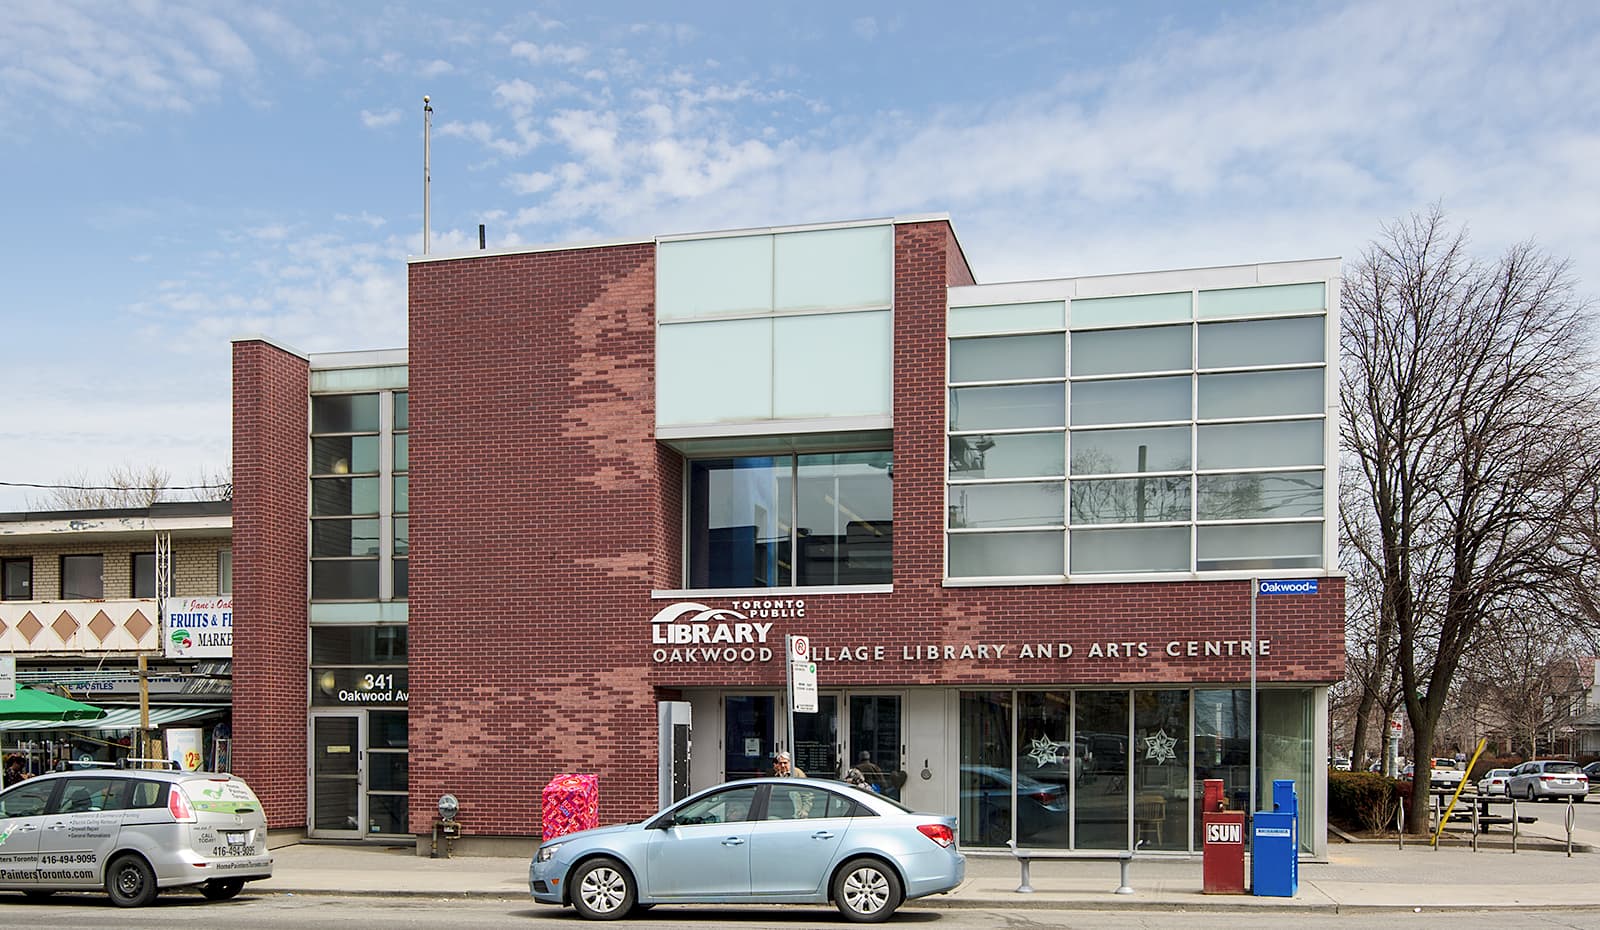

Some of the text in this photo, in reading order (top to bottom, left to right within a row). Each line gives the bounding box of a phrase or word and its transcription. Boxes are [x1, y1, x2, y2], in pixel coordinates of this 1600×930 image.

[1261, 582, 1309, 592] Oakwood
[190, 599, 214, 612] Jane's
[732, 600, 805, 610] TORONTO
[750, 609, 805, 618] PUBLIC
[170, 613, 209, 628] FRUITS
[211, 614, 218, 626] &
[652, 623, 774, 644] LIBRARY
[653, 639, 1271, 662] OAKWOOD LLAGE LIBRARY AND ARTS CENTRE
[364, 674, 393, 690] 341
[338, 690, 392, 701] Oakwood
[1211, 825, 1240, 842] SUN
[213, 846, 255, 856] 416-494-9095
[41, 854, 97, 864] 416-494-9095
